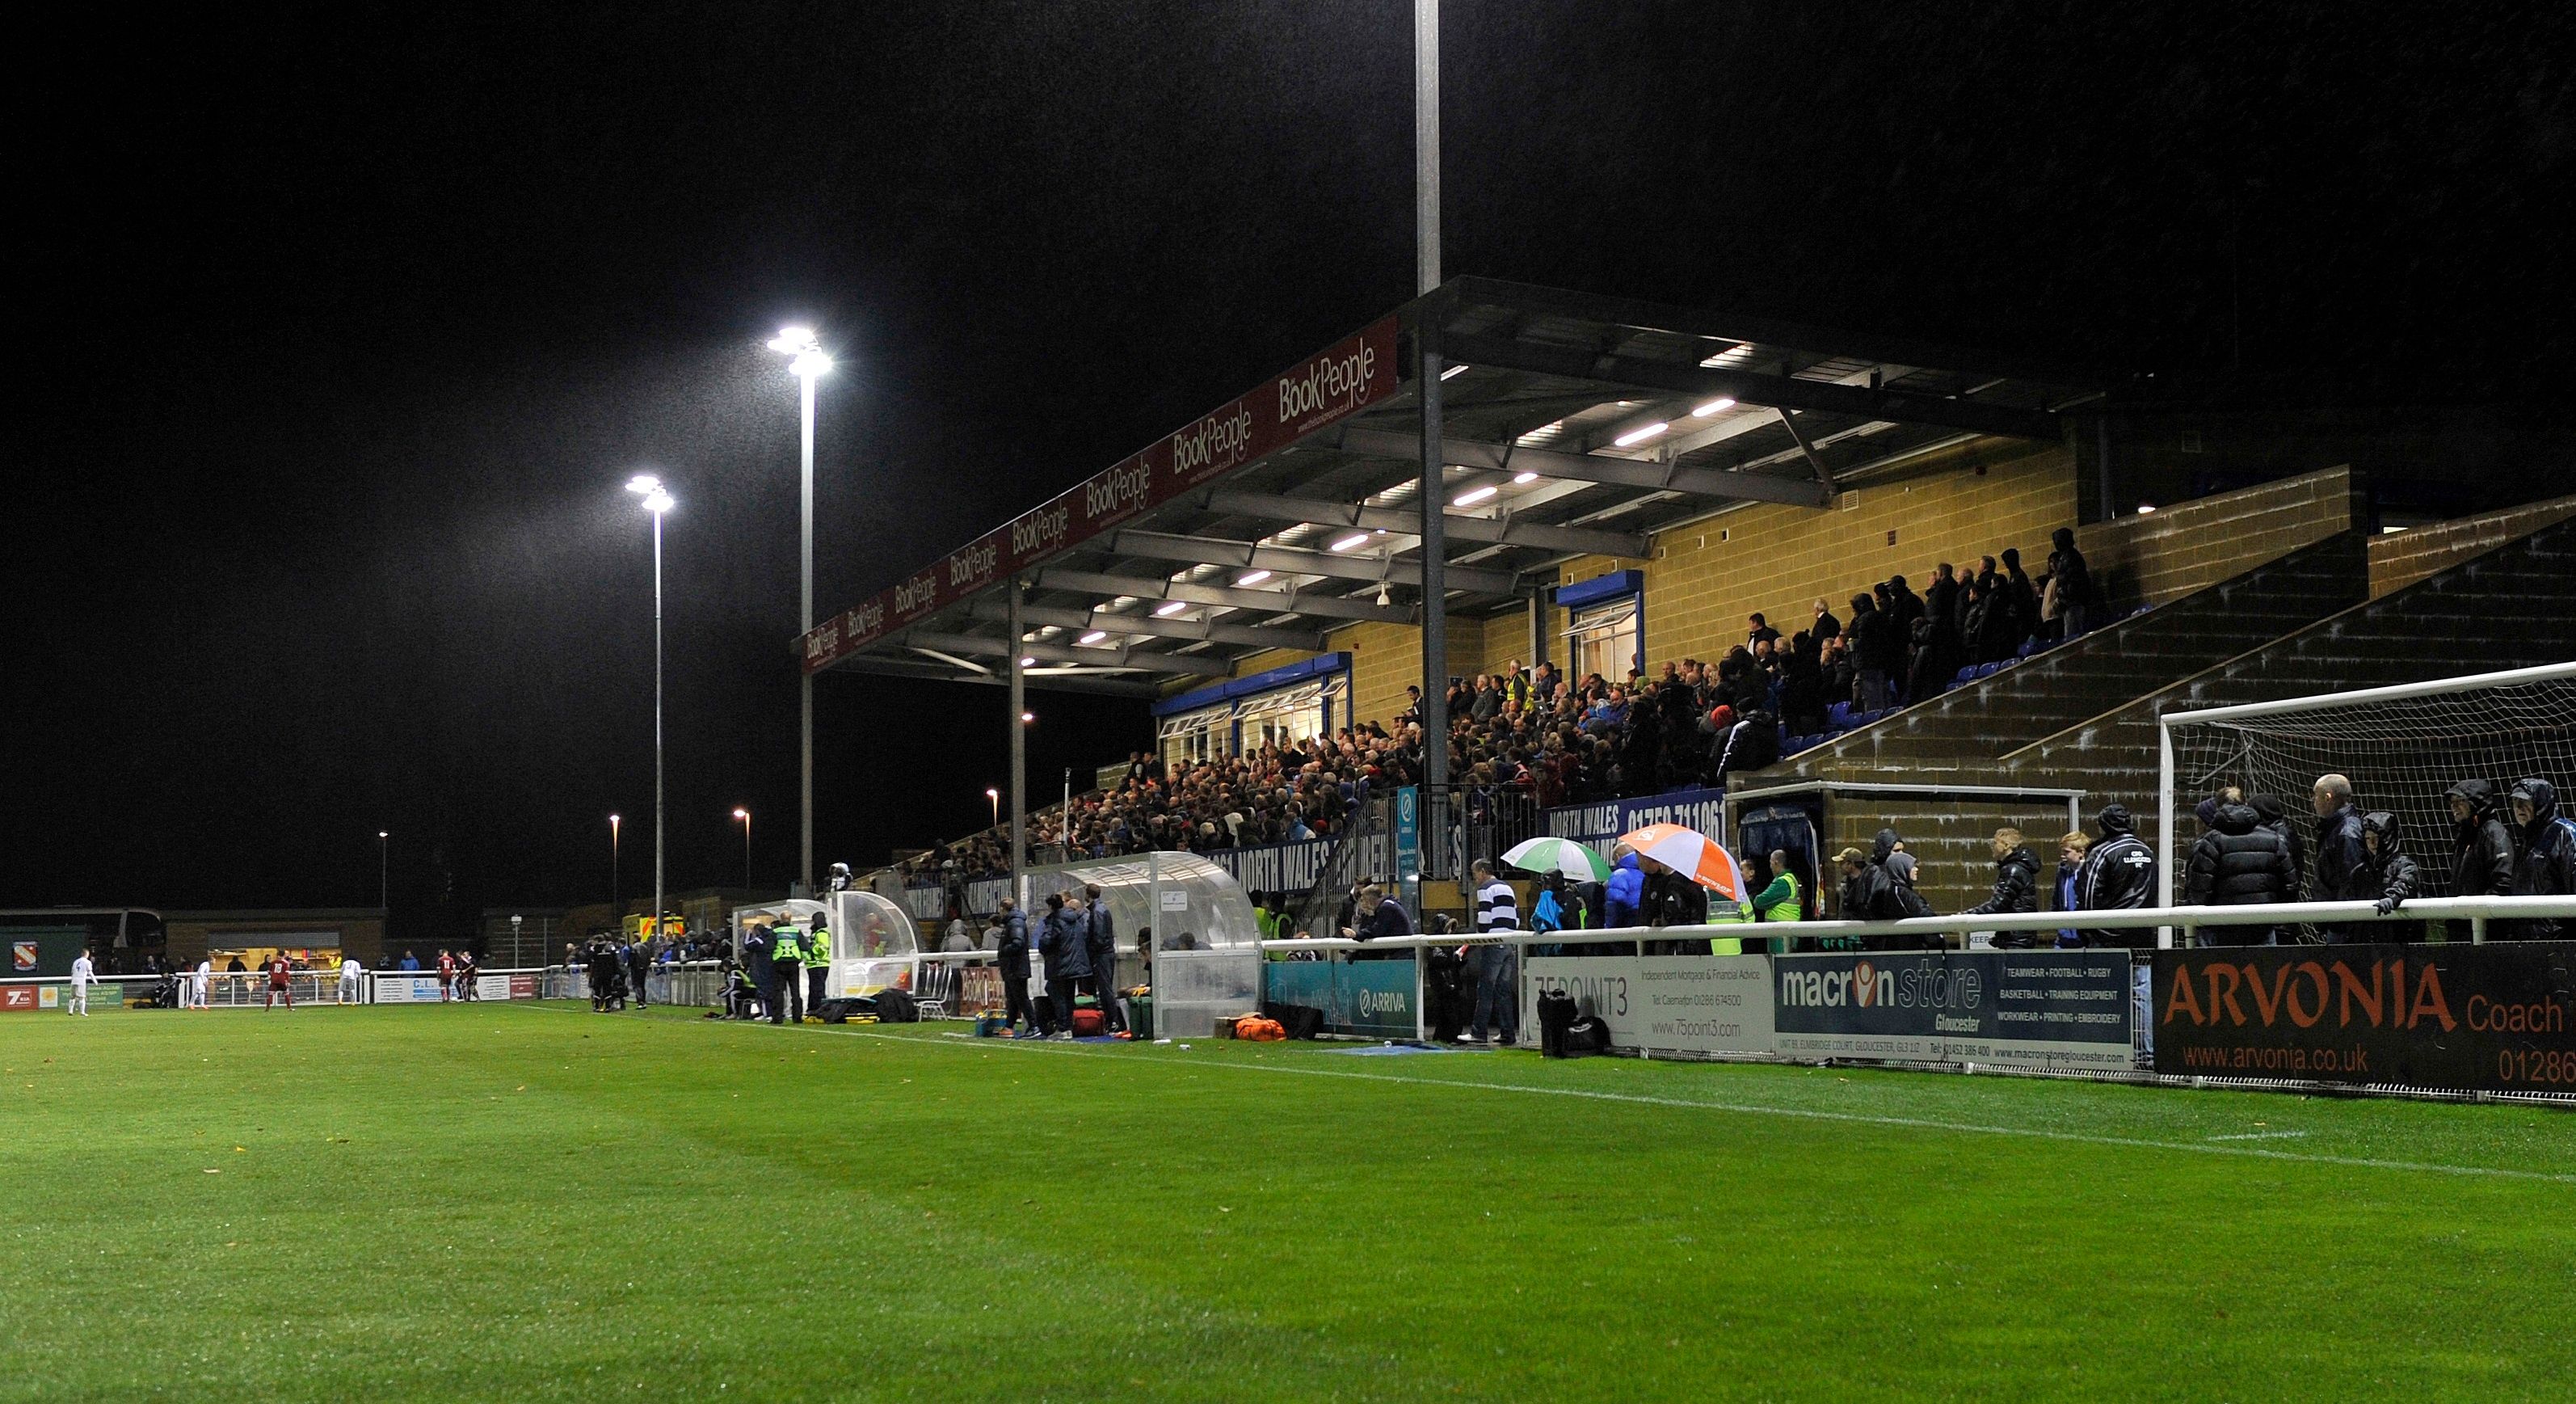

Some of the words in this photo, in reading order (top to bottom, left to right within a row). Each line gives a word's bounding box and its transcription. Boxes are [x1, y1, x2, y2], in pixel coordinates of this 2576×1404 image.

[1550, 808, 1581, 837] NORTH
[1585, 804, 1619, 835] WALES
[1238, 848, 1279, 893] NORTH
[1283, 841, 1329, 890] WALES
[1641, 970, 1677, 982] Independent
[1677, 970, 1705, 983] Mortgage
[1712, 969, 1738, 980] Financial
[1739, 969, 1761, 980] Advice
[2007, 968, 2045, 978] TEAMWEAR
[2049, 968, 2083, 978] FOOTBALL
[2087, 968, 2111, 978] RUGBY
[1899, 959, 1981, 1009] store
[1371, 992, 1406, 1012] ARRIVA
[2000, 989, 2044, 1000] BASKETBALL
[2049, 990, 2079, 1000] TRAINING
[2080, 990, 2118, 1001] EQUIPMENT
[2162, 958, 2457, 1033] ARVONIA
[2467, 994, 2563, 1032] Coach
[1935, 1013, 1980, 1032] Gloucester
[1997, 1011, 2039, 1022] WORKWEAR
[2044, 1013, 2073, 1022] PRINTING
[2077, 1013, 2121, 1023] EMBROIDERY
[1652, 1018, 1740, 1039] www.75point3.com
[1993, 1048, 2125, 1064] www.macronstoregloucester.com
[2184, 1043, 2369, 1073] www.arvonia.co.uk
[2498, 1049, 2576, 1083] 01286
